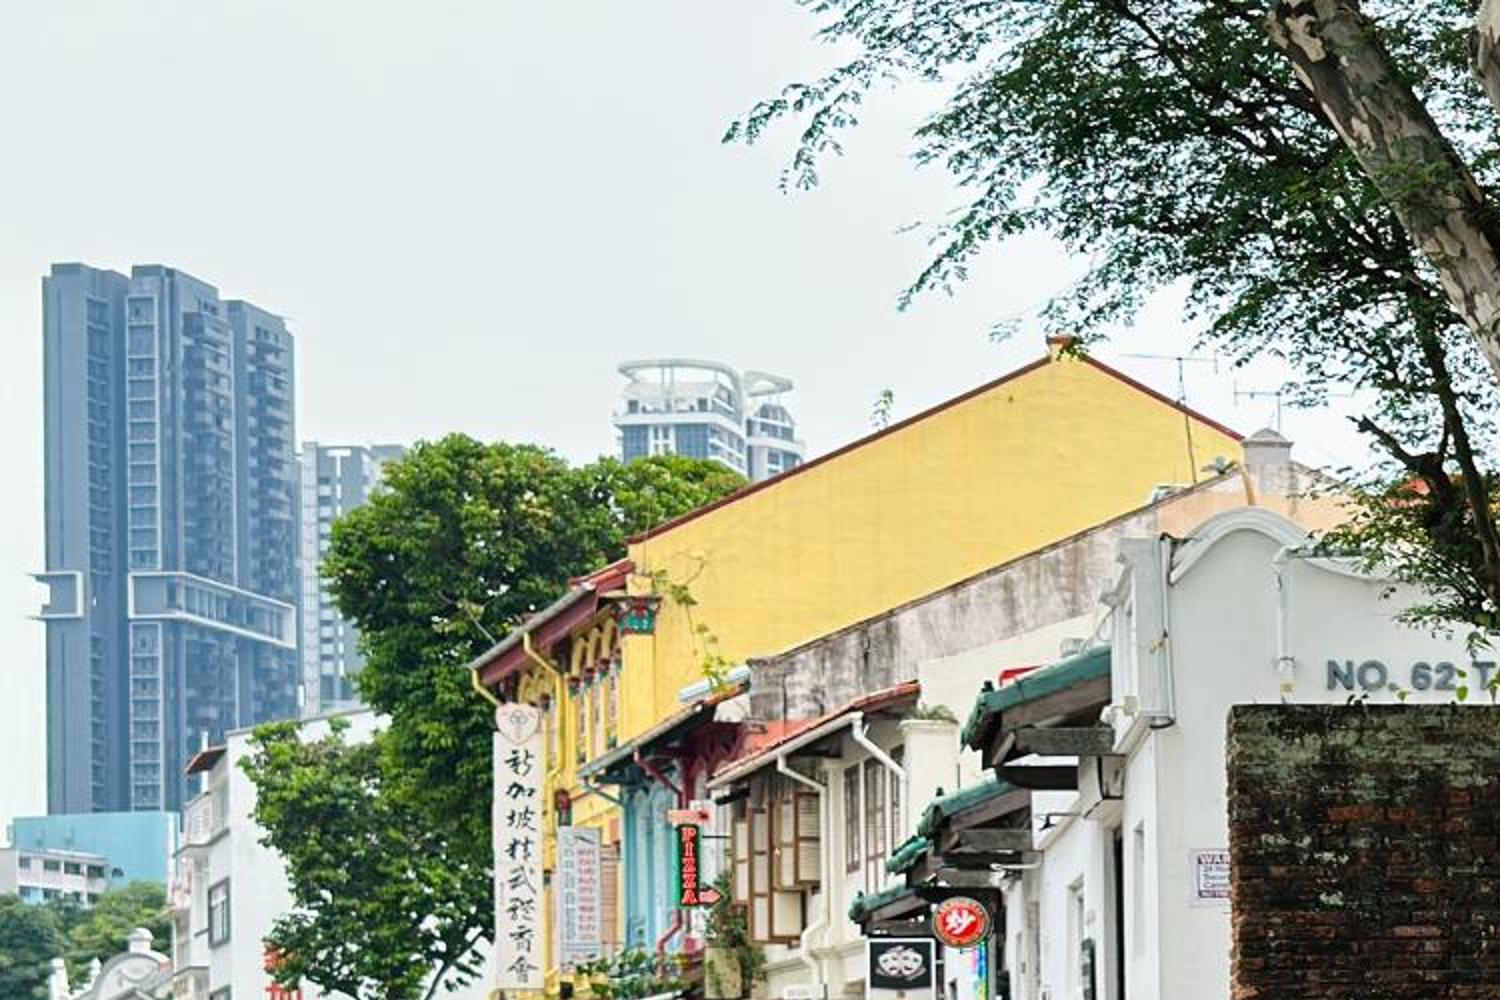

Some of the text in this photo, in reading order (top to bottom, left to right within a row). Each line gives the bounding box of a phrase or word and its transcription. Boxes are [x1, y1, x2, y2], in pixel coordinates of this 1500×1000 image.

[1326, 659, 1398, 691] NO.
[1410, 661, 1457, 691] 62
[681, 826, 698, 905] PIZZA
